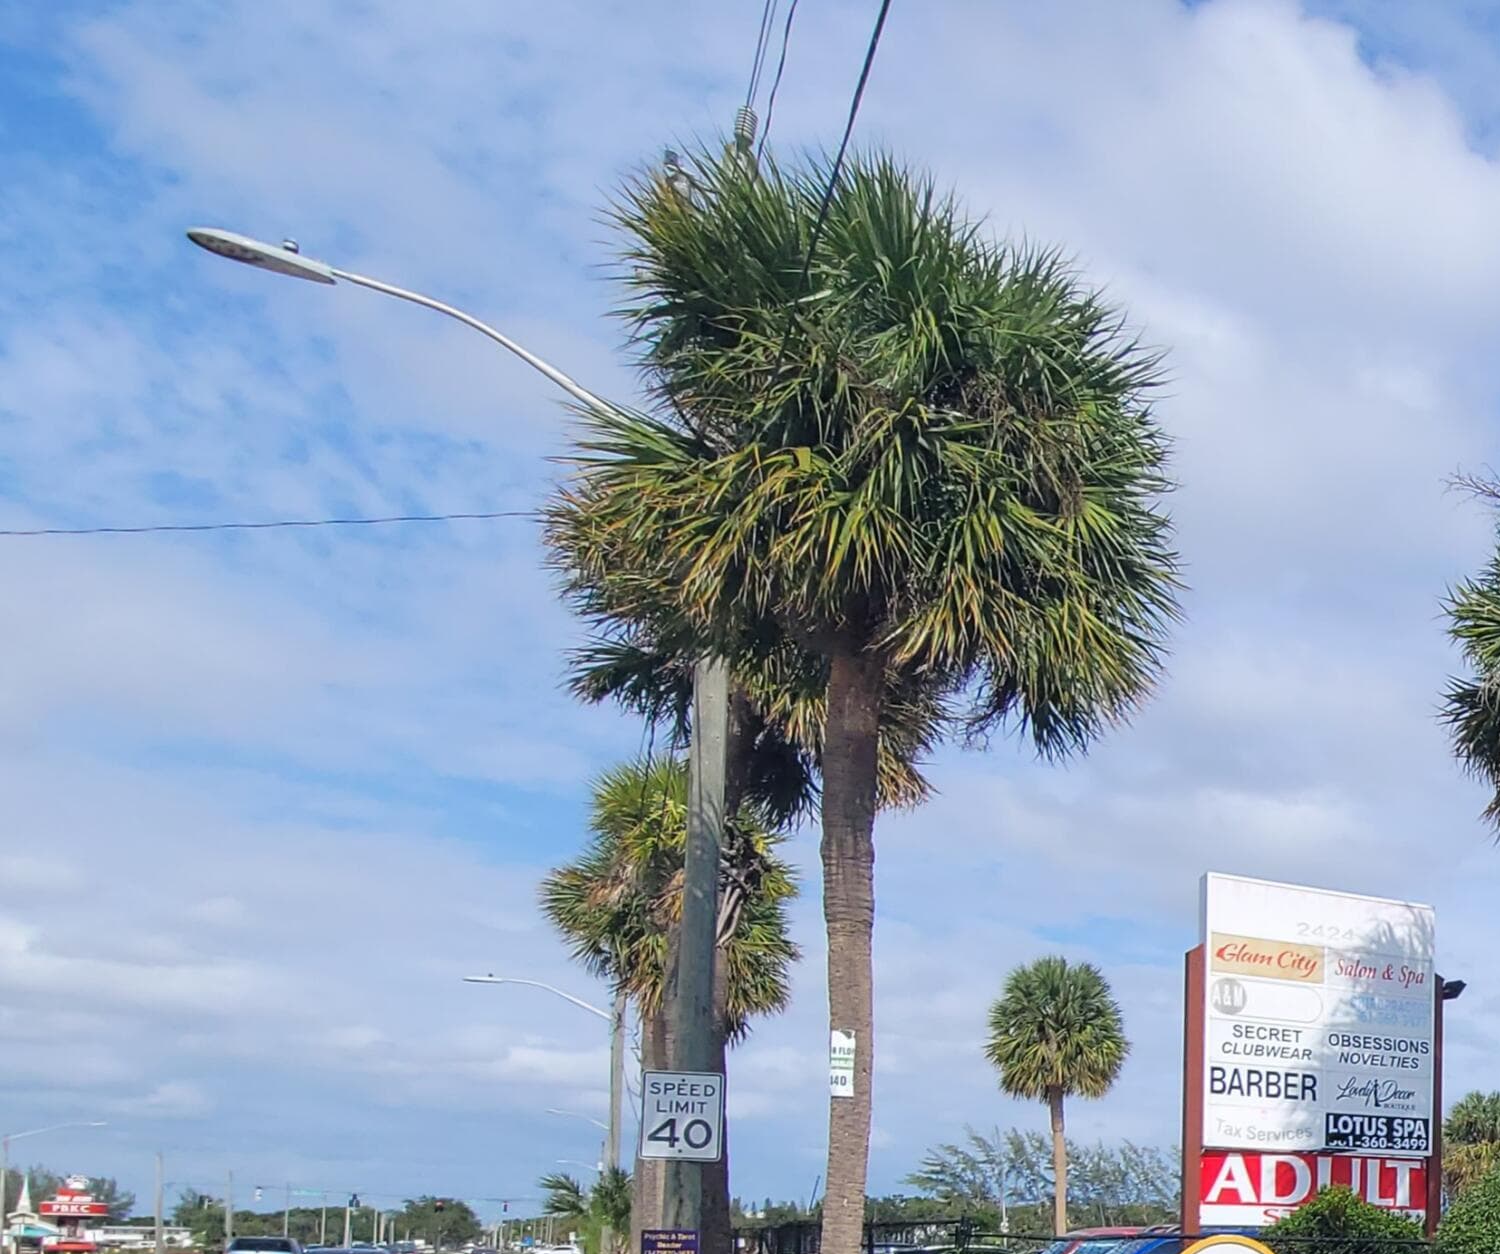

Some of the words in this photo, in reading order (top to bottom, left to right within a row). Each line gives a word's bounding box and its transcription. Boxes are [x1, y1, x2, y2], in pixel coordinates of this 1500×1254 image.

[1296, 922, 1354, 939] 2424
[1216, 943, 1273, 965] Glam
[1277, 950, 1318, 978] City
[1335, 959, 1377, 979] Salon
[1382, 964, 1394, 980] &
[1398, 965, 1425, 988] Spa
[1232, 1023, 1303, 1043] SECRET
[1328, 1033, 1430, 1054] OBSESSIONS
[1221, 1041, 1313, 1061] CLUBWEAR
[1338, 1052, 1420, 1070] NOVELTIES
[650, 1082, 716, 1097] SPEED
[1210, 1065, 1318, 1102] BARBER
[656, 1100, 708, 1115] LIMIT
[647, 1118, 713, 1149] 40
[1215, 1117, 1242, 1138] Tax
[1246, 1126, 1314, 1142] Services
[1328, 1114, 1388, 1137] LOTUS
[1392, 1118, 1427, 1138] SPA
[1205, 1153, 1421, 1207] ADULT
